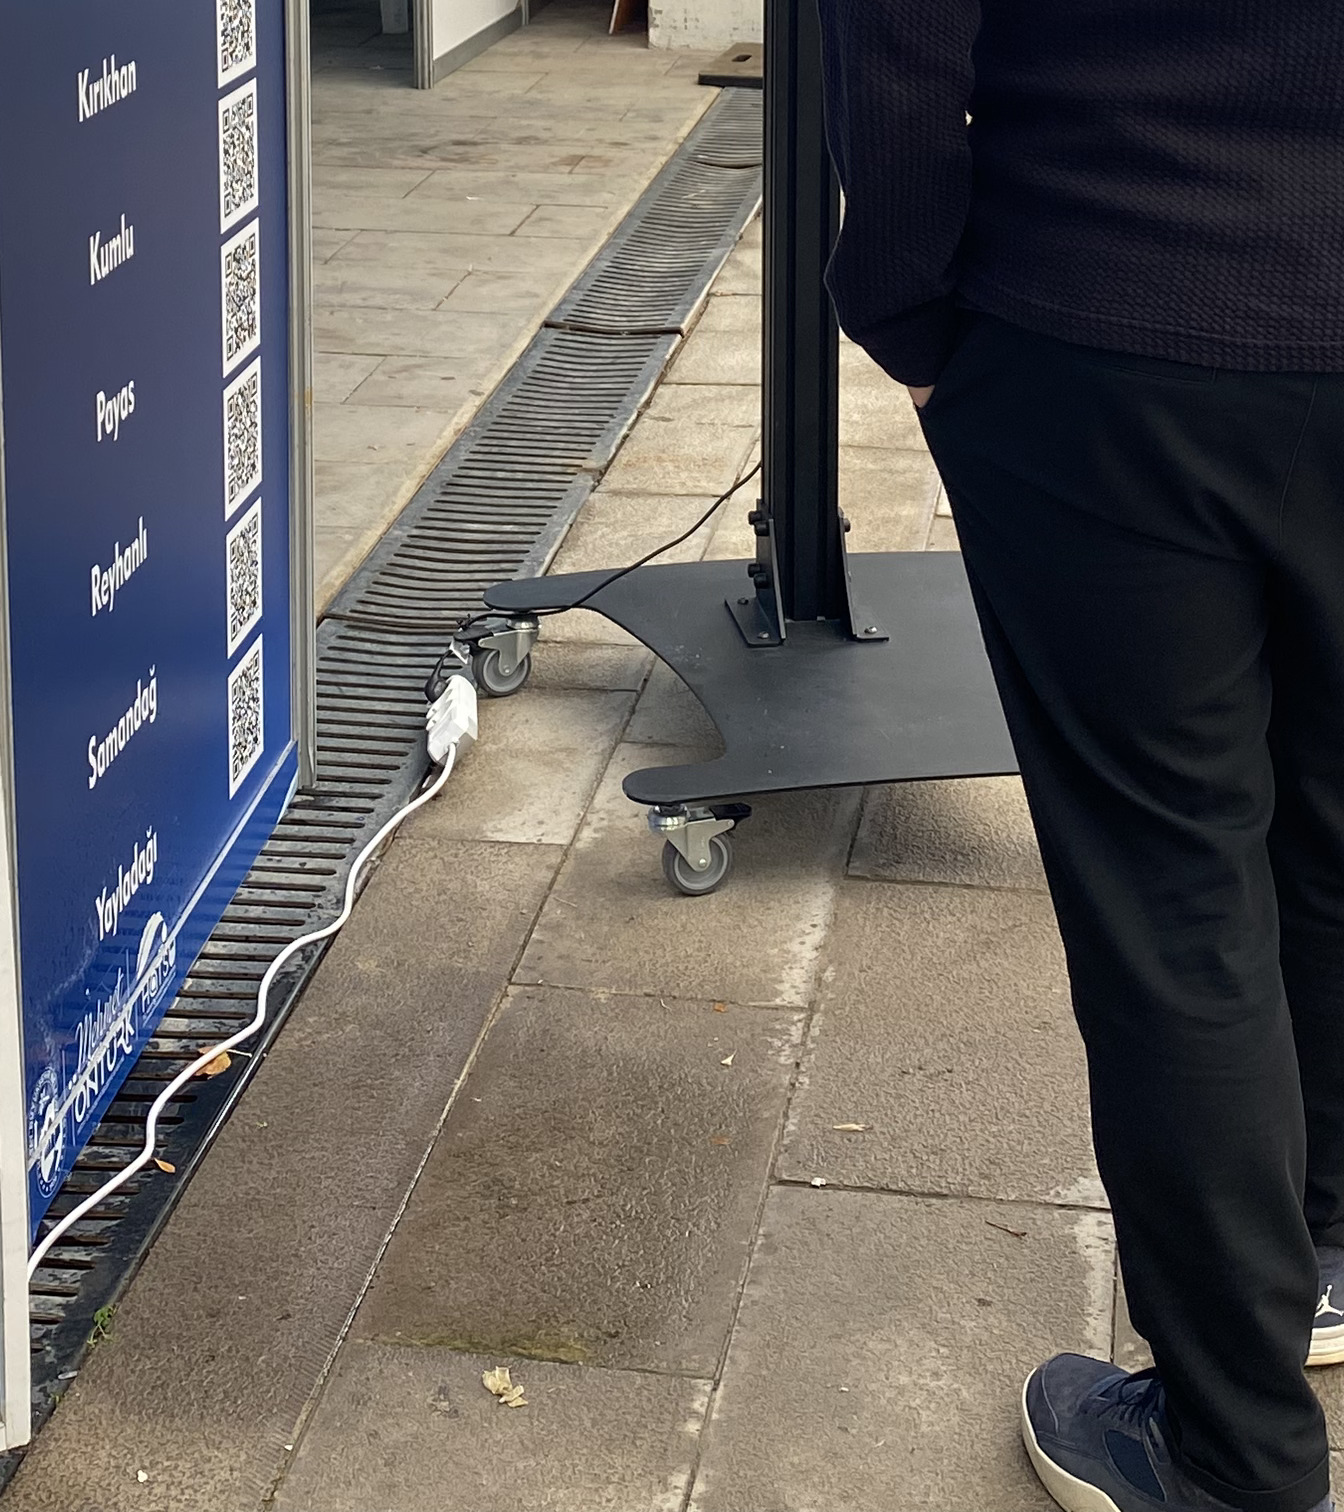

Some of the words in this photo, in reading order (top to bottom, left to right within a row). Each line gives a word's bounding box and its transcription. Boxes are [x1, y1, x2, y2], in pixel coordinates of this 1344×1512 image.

[78, 53, 137, 123] Kırıkhan
[89, 213, 134, 286] Kumlu
[96, 380, 135, 442] Payas
[91, 516, 148, 617] Reyhanlı
[88, 664, 157, 789] Samandağ
[95, 826, 158, 941] Yayladağı
